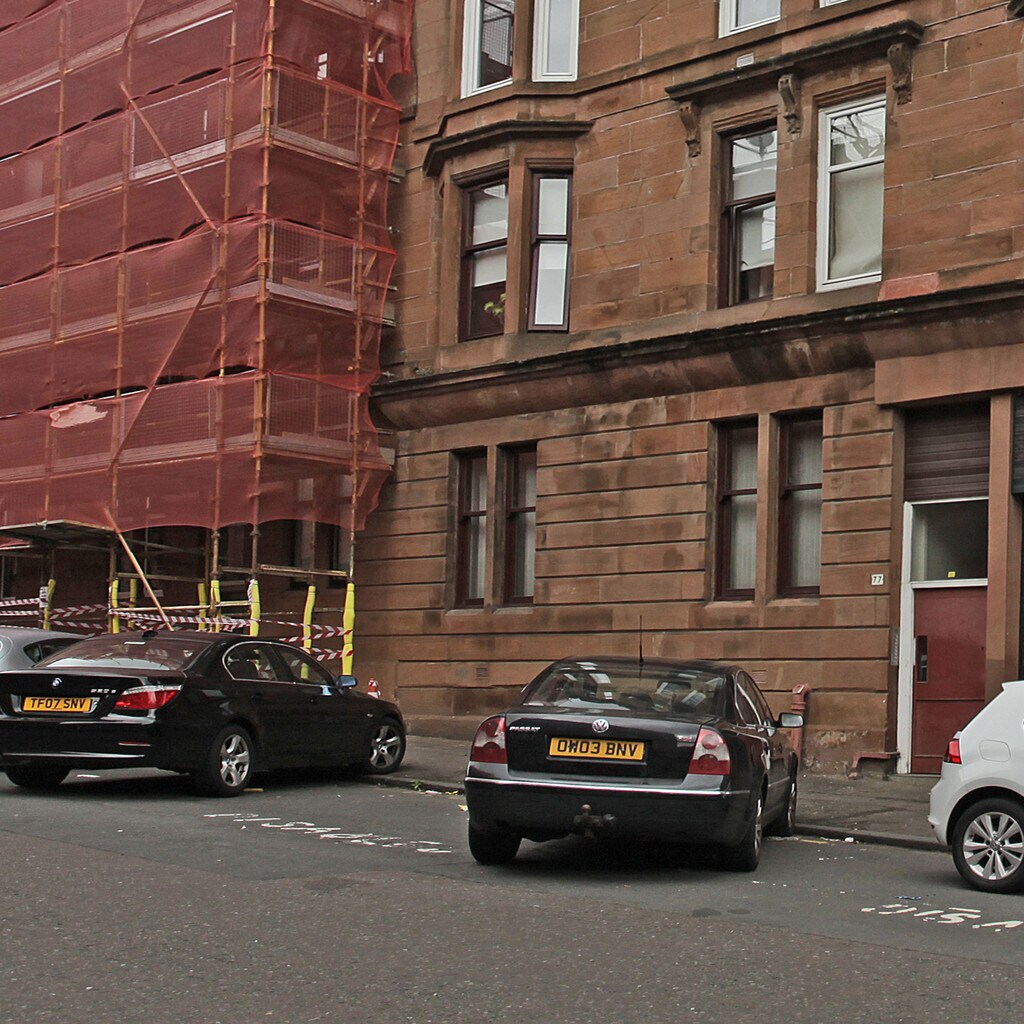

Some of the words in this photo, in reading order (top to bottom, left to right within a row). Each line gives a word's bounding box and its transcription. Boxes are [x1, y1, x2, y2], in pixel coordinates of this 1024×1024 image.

[31, 698, 60, 709] TF07
[63, 699, 85, 709] SNV
[605, 742, 638, 756] BNV
